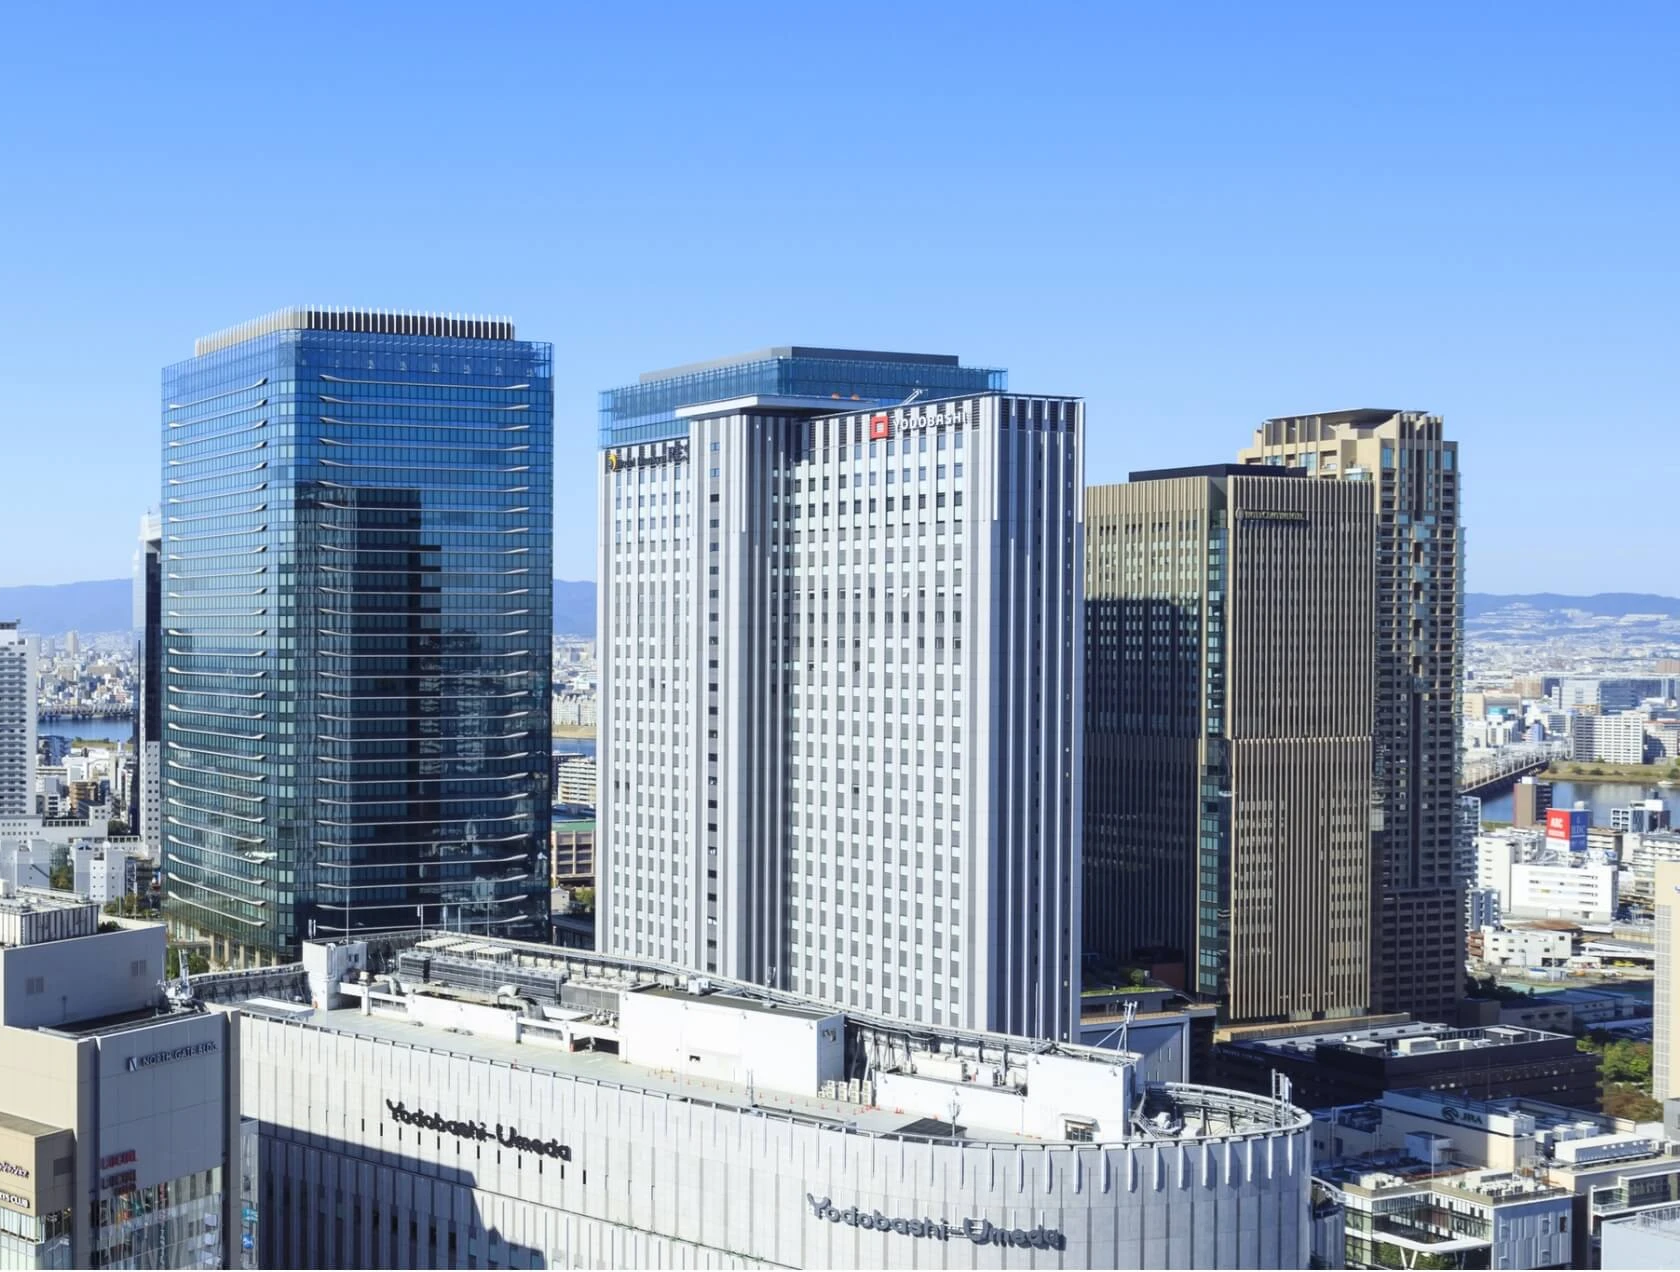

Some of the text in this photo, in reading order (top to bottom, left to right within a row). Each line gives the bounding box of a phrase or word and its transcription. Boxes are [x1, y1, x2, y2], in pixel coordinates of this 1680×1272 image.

[894, 411, 968, 431] YODOBASHI
[141, 1052, 171, 1066] NORTH
[173, 1046, 196, 1060] GATE
[1461, 1112, 1483, 1124] JRA
[386, 1098, 571, 1162] Yodobashi-Umeda
[10, 1195, 29, 1208] CLUB
[807, 1193, 1066, 1250] Yodobashi-Umeda
